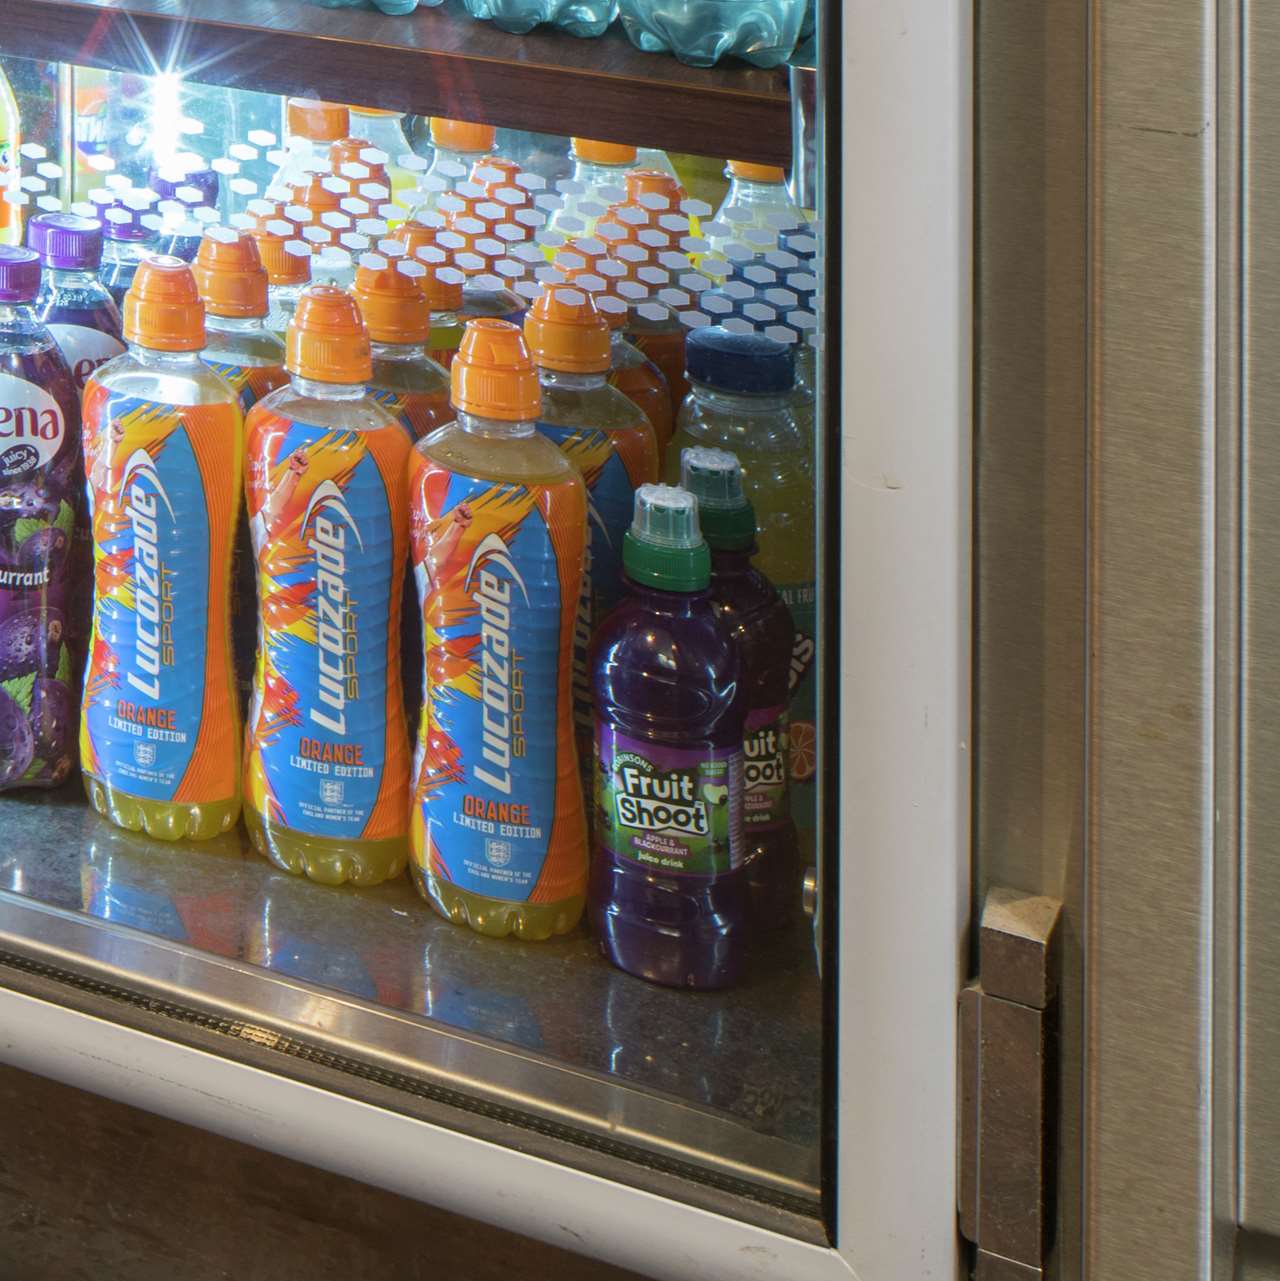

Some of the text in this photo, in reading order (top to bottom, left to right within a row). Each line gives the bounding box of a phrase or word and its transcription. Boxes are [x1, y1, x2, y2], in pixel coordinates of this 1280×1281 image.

[1, 449, 28, 467] juicy
[127, 483, 162, 701] Lucozade
[160, 562, 176, 667] SPORT
[310, 516, 346, 736] Lucozade
[343, 596, 360, 701] SPORT
[472, 569, 512, 795] Lucozade
[116, 699, 177, 730] ORANGE
[511, 649, 526, 758] SPORT
[108, 715, 187, 743] LIMITED EDITION
[744, 731, 776, 757] uit
[290, 755, 375, 778] LIMITED EDITION
[299, 737, 365, 766] ORANGE
[622, 766, 694, 801] Fruit
[453, 811, 542, 839] LIMITED EDITION
[463, 794, 532, 826] ORANGE
[620, 796, 706, 833] Shoot
[633, 836, 689, 856] BLACKCURRANT
[646, 833, 676, 847] APPLE &
[638, 852, 685, 869] juice drink
